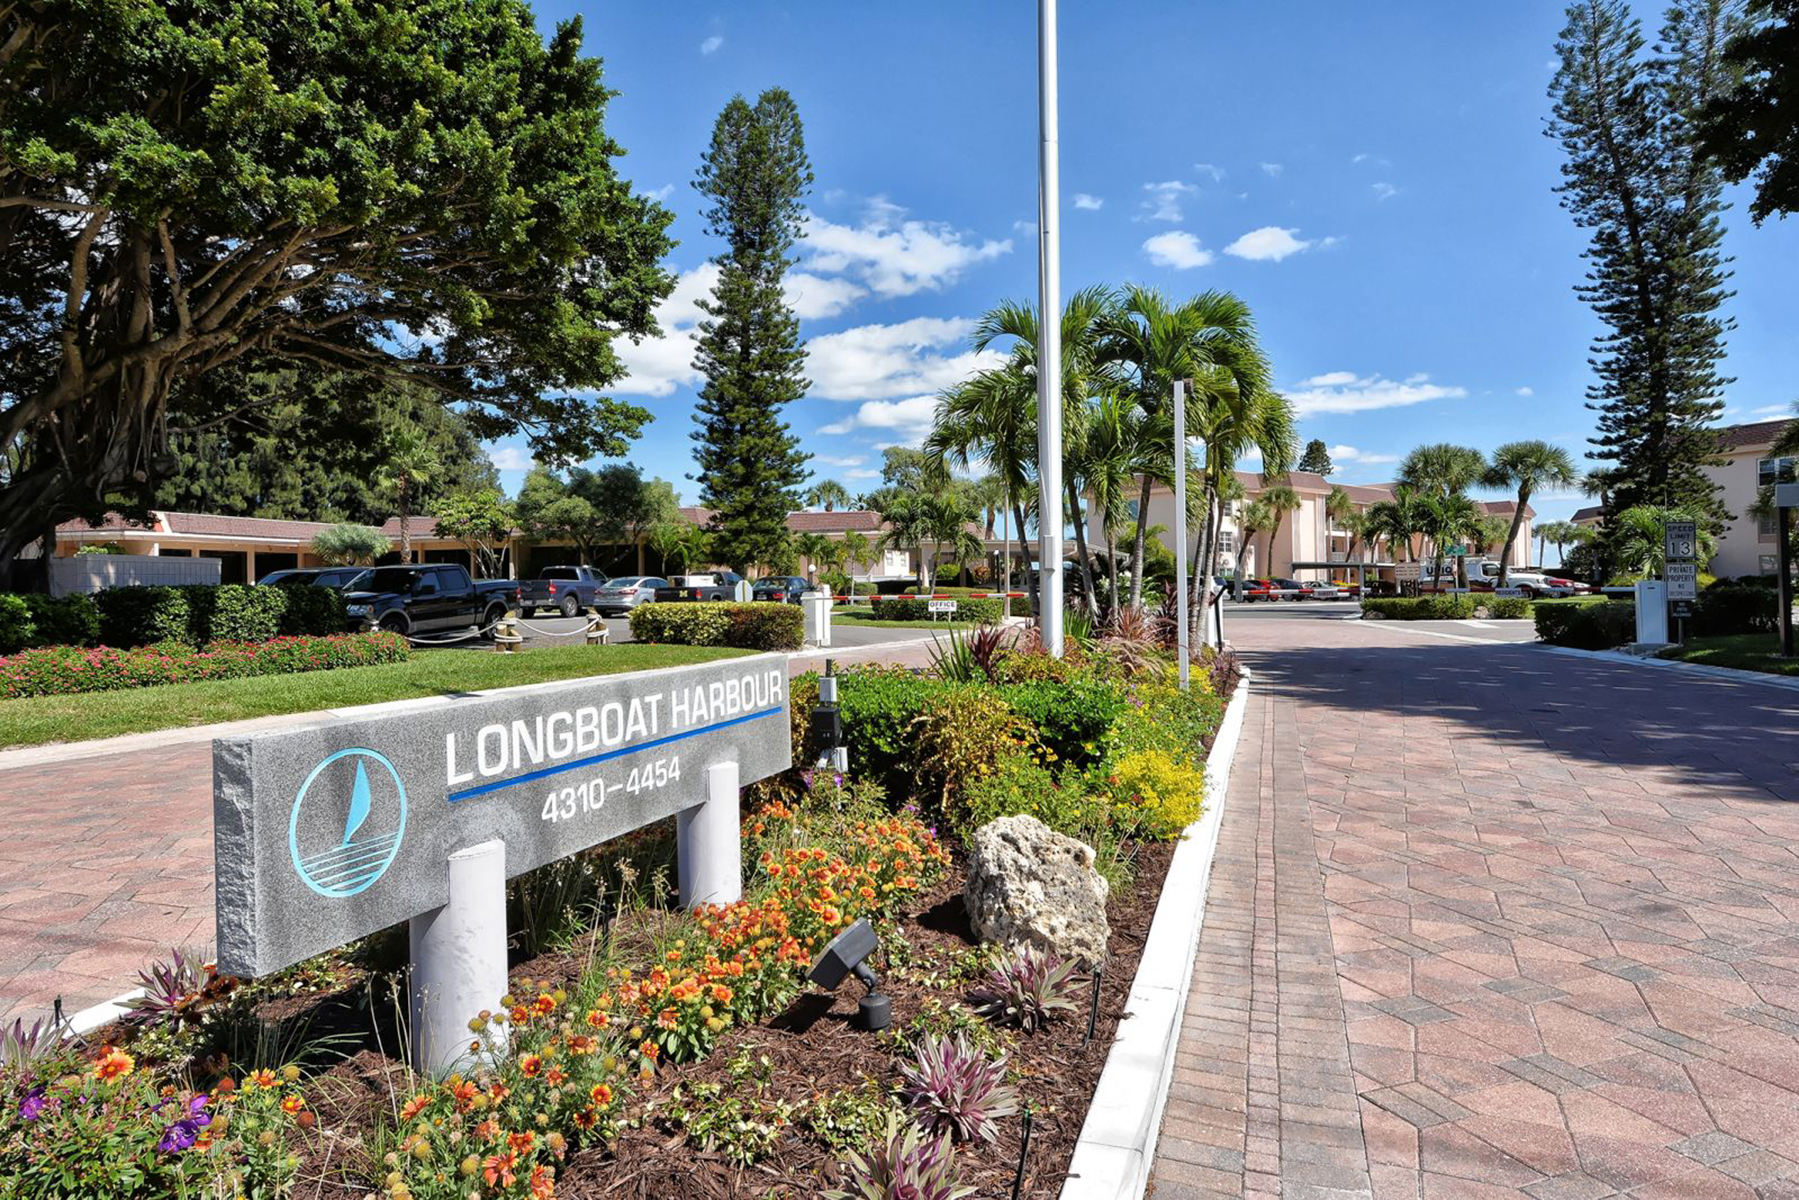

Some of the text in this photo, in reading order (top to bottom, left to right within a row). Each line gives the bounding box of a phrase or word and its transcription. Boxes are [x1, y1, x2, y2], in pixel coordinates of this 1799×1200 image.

[1671, 541, 1691, 556] 13
[1669, 566, 1693, 574] PRIVATE
[1667, 574, 1694, 582] PROPERTY
[446, 670, 782, 785] LONGBOAT HARBOUR
[541, 755, 681, 823] 4310-4454
